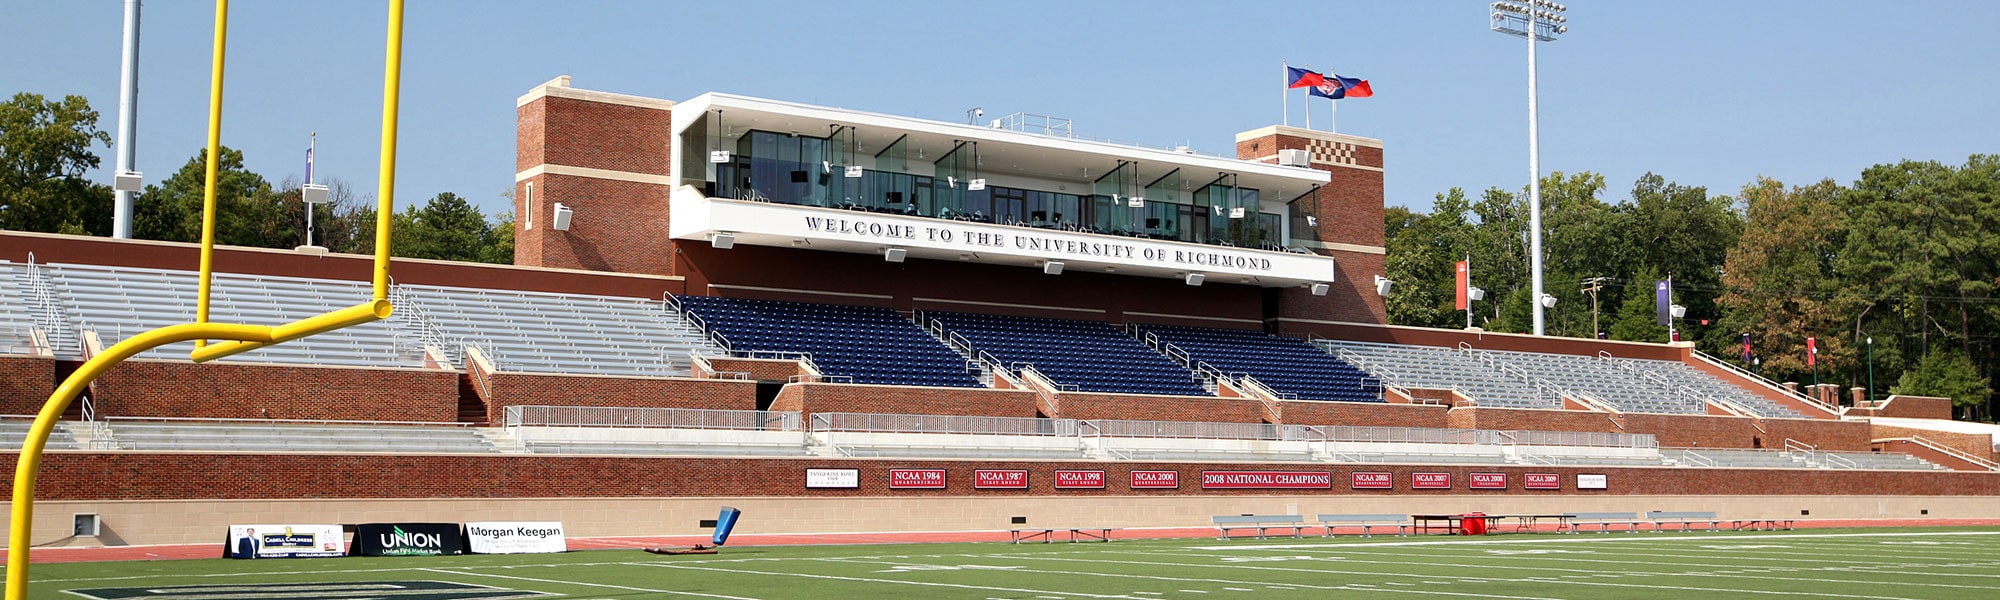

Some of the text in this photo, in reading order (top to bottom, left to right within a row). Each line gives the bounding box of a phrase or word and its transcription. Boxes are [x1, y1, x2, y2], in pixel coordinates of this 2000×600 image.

[805, 216, 1272, 270] WELCOME TO THE UNIVERSITY OF RICHMOND
[895, 471, 940, 480] NCAA 1984
[980, 472, 1023, 480] NCAA 1987
[1060, 472, 1100, 480] NCAA 1998
[1135, 473, 1174, 481] NCAA 2000
[1204, 474, 1329, 484] 2008 NATIONAL CHAMPIONS
[470, 526, 560, 539] Morgan Keegan
[380, 532, 441, 548] UNION
